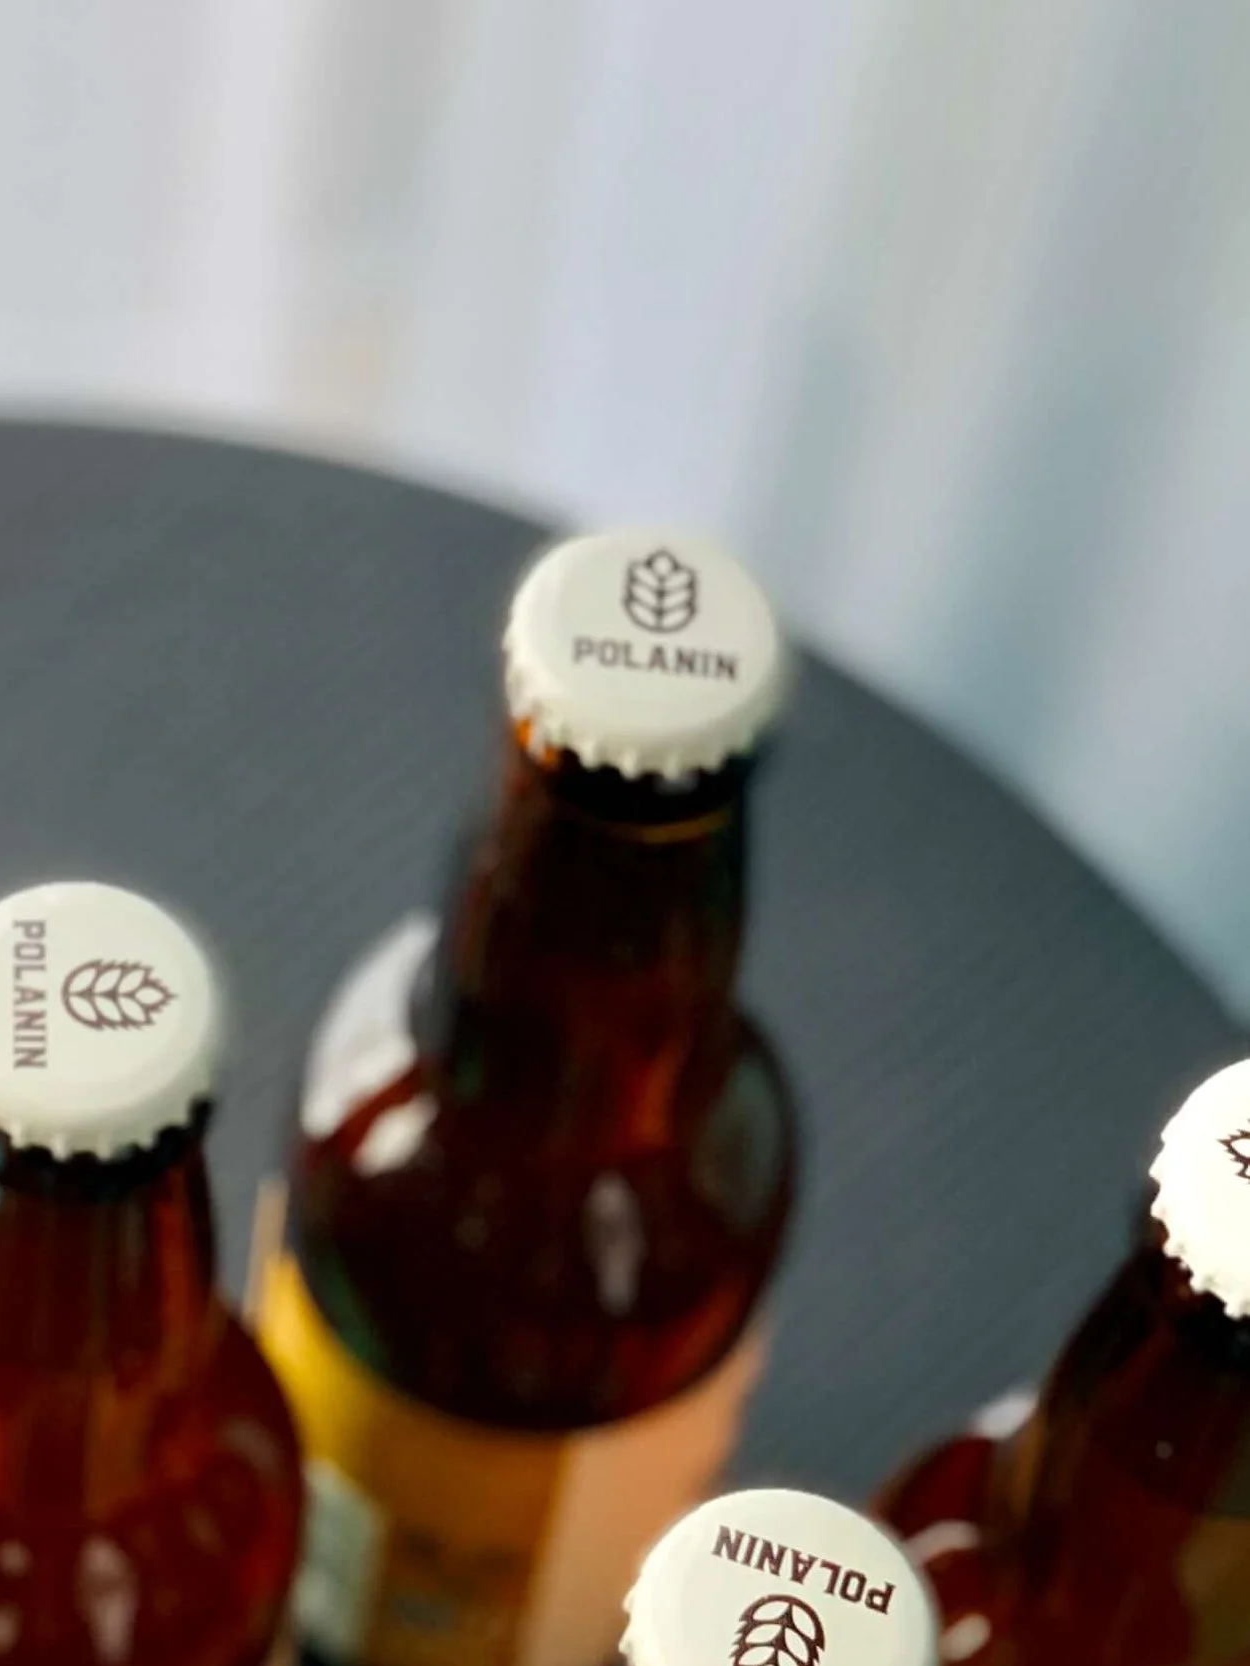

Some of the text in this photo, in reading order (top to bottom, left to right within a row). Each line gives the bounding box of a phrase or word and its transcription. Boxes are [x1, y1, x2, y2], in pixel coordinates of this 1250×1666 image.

[572, 636, 737, 681] POLANIN
[12, 919, 47, 1070] POLANIN
[711, 1525, 896, 1614] POLANIN
